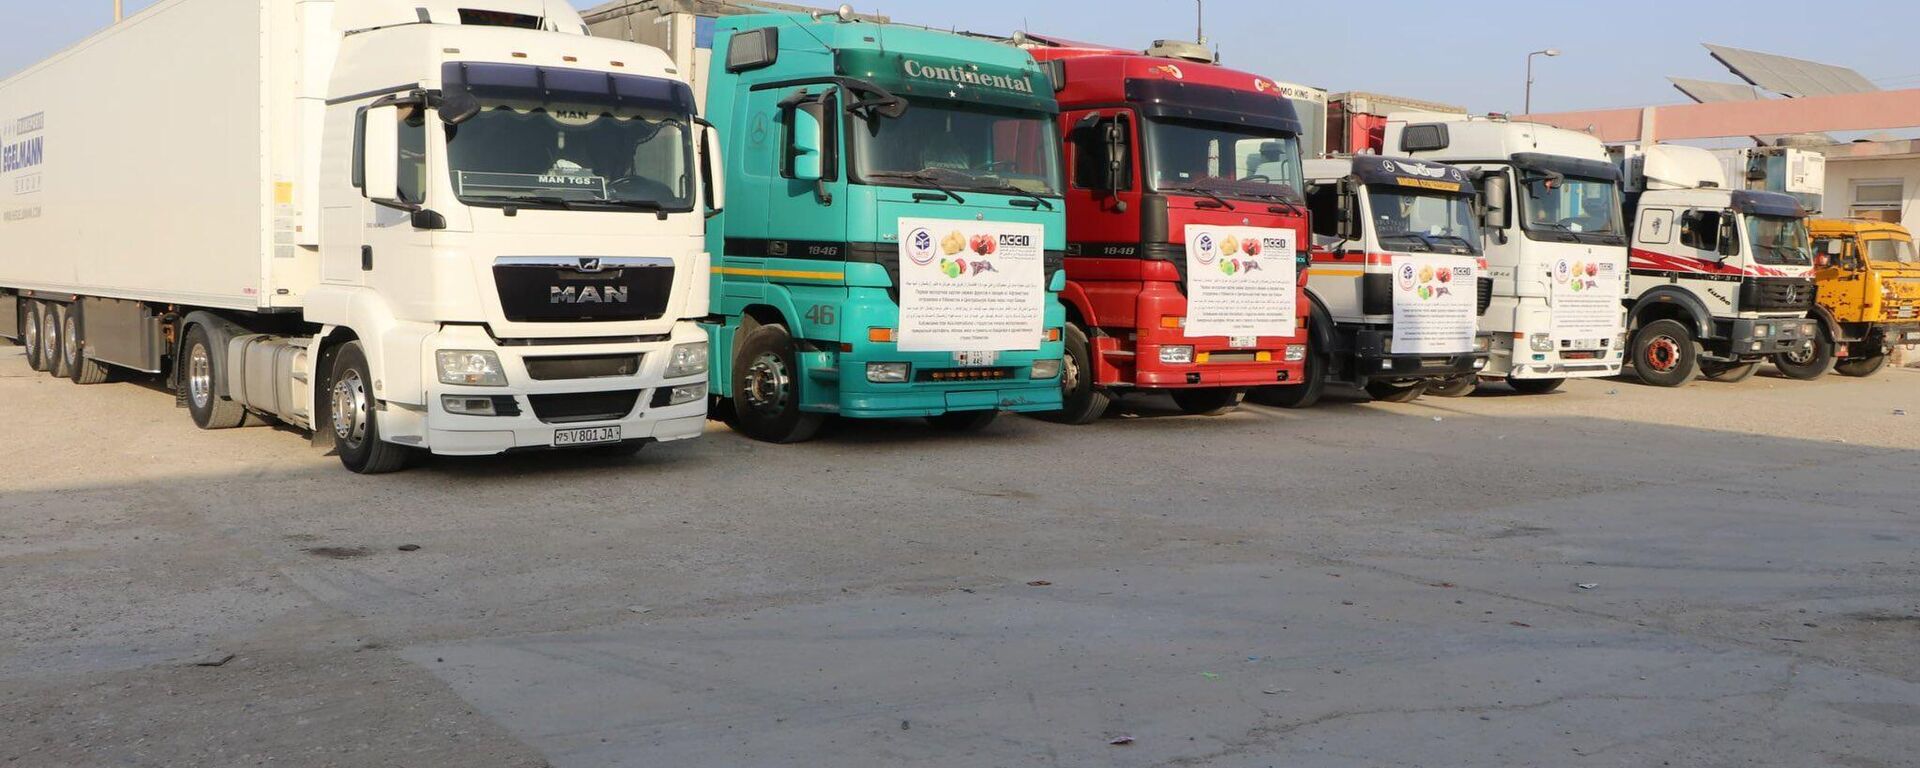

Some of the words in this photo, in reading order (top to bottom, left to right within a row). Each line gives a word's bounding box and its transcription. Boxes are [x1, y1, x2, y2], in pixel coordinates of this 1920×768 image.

[903, 59, 1033, 93] Continental
[556, 109, 589, 120] MAN
[0, 136, 43, 173] EGELMANN
[538, 175, 566, 185] MAN
[568, 176, 591, 185] TGS
[999, 234, 1030, 247] ACCI
[808, 246, 838, 256] 1846
[550, 285, 628, 304] MAN
[1707, 287, 1731, 306] turbo
[804, 303, 835, 326] 46
[558, 432, 569, 442] 75
